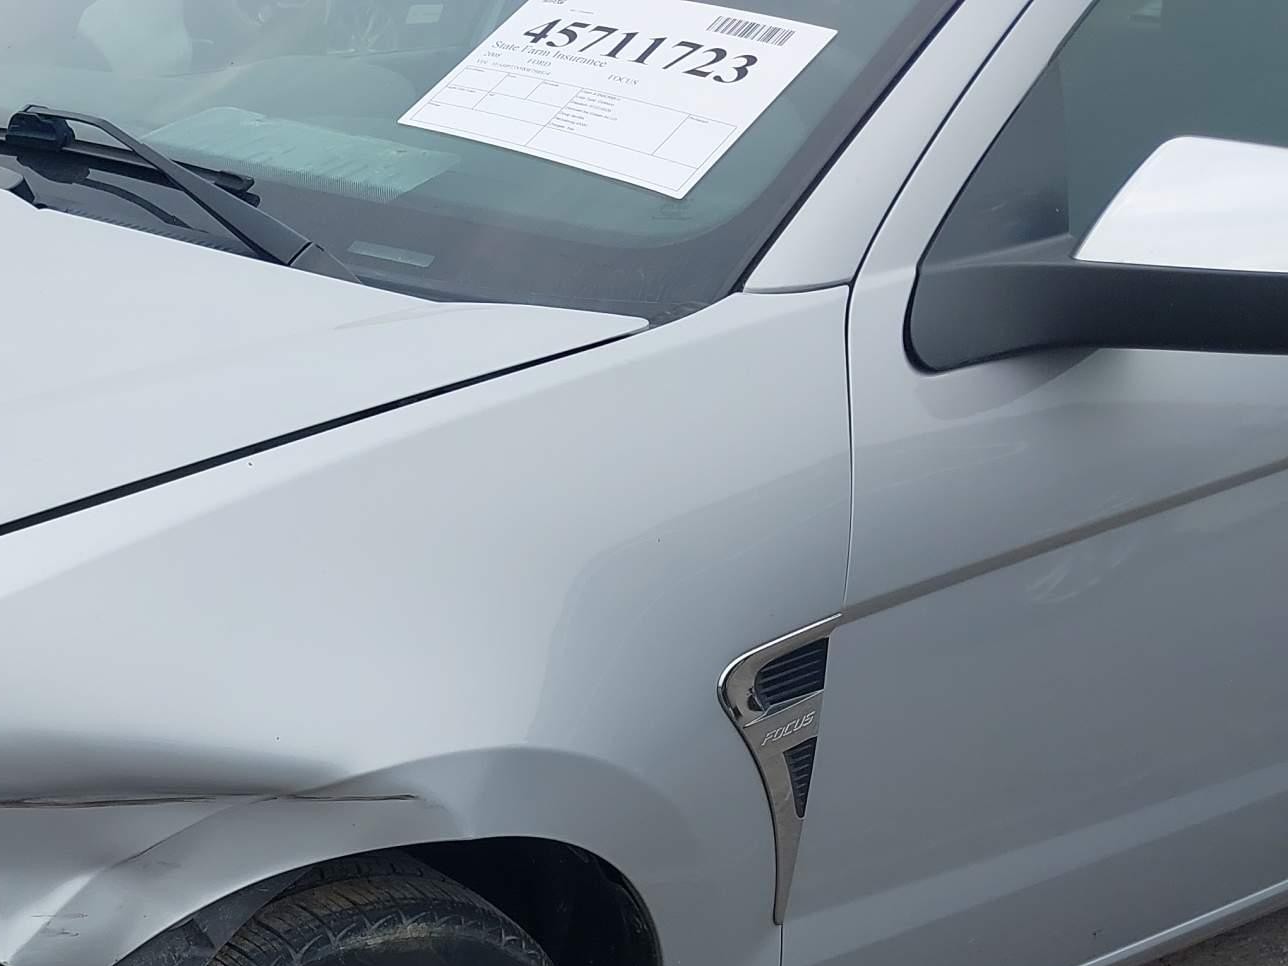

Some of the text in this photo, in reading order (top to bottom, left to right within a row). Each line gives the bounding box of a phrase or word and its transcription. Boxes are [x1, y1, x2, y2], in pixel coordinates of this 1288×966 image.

[491, 40, 520, 51] State
[521, 45, 551, 57] Farm
[552, 51, 608, 68] Insurance
[523, 18, 758, 84] 45711723
[761, 711, 816, 746] FOCUS
